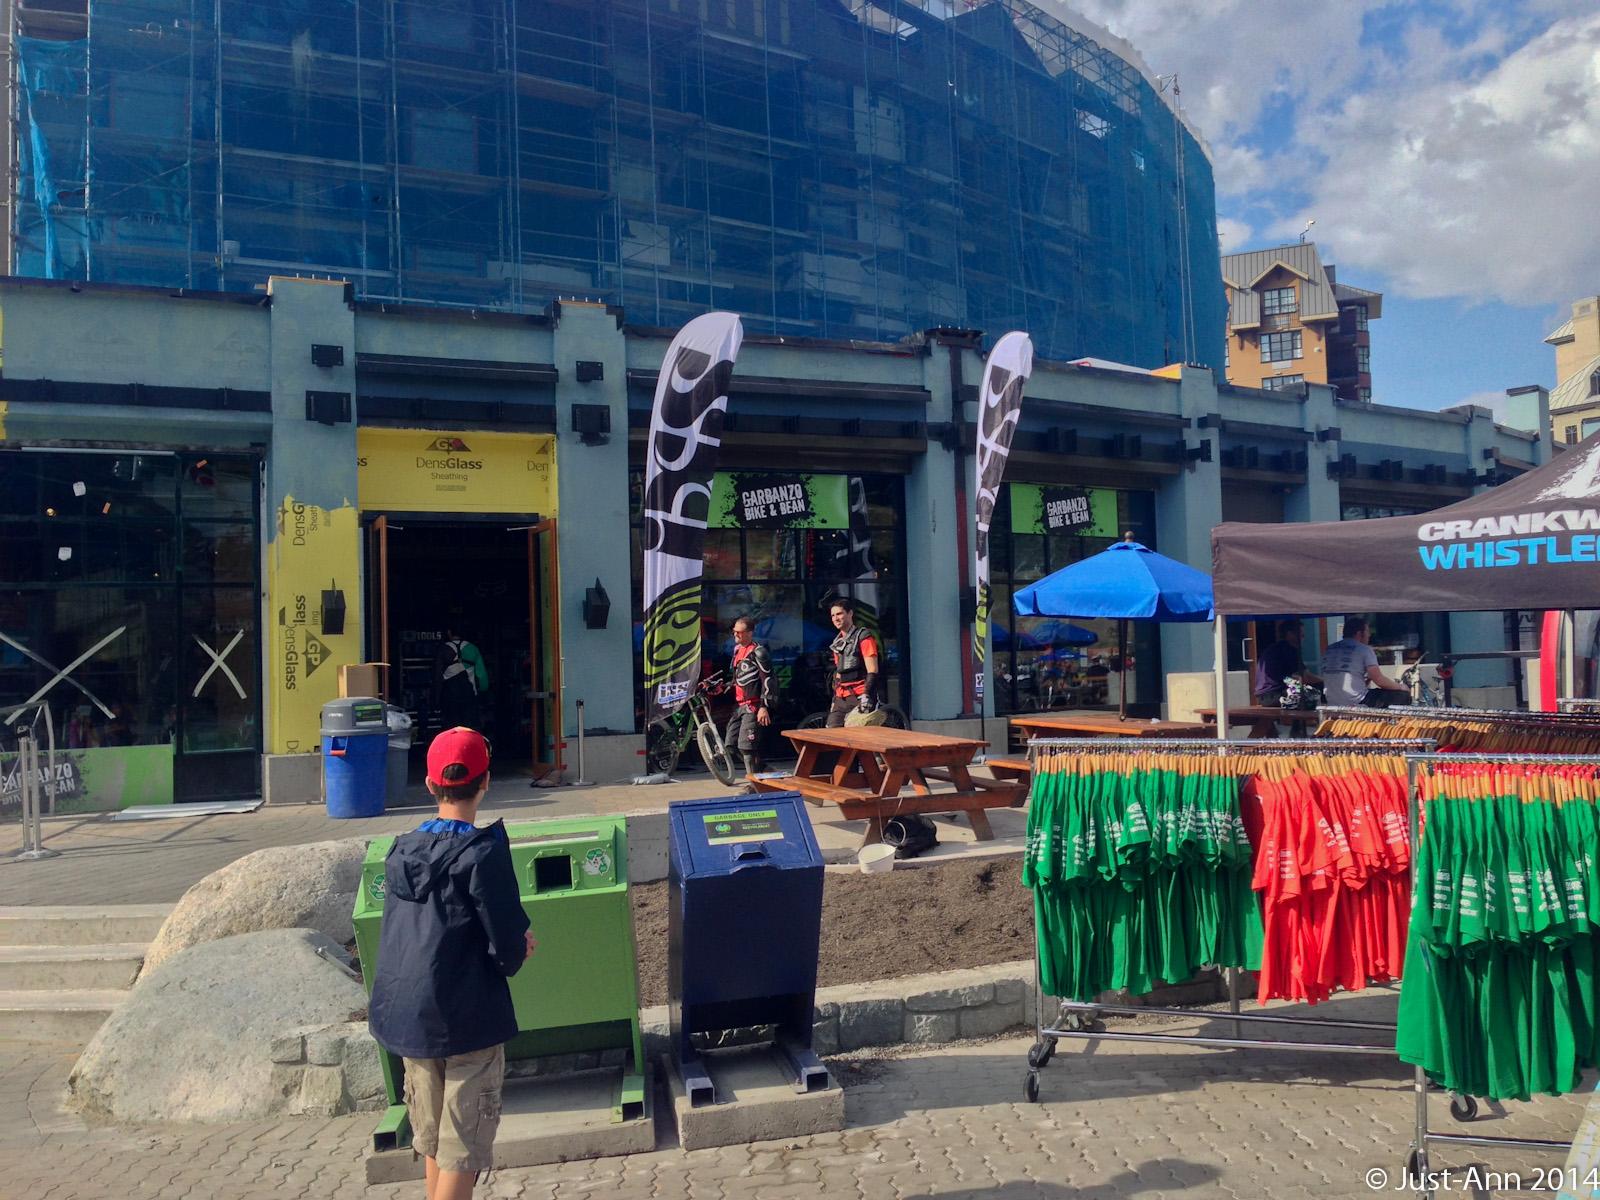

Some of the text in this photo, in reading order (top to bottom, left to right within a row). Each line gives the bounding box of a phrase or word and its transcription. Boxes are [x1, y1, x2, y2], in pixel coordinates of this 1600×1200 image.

[416, 456, 482, 470] DensGlass
[431, 472, 468, 482] Sheathing
[742, 483, 803, 508] GARBANZO
[744, 499, 806, 521] BIKE & BEAN
[1046, 496, 1088, 517] GARBANZO
[1048, 510, 1090, 529] BIKE & BEAN
[1418, 534, 1600, 571] WHISTLE
[307, 639, 321, 666] GP
